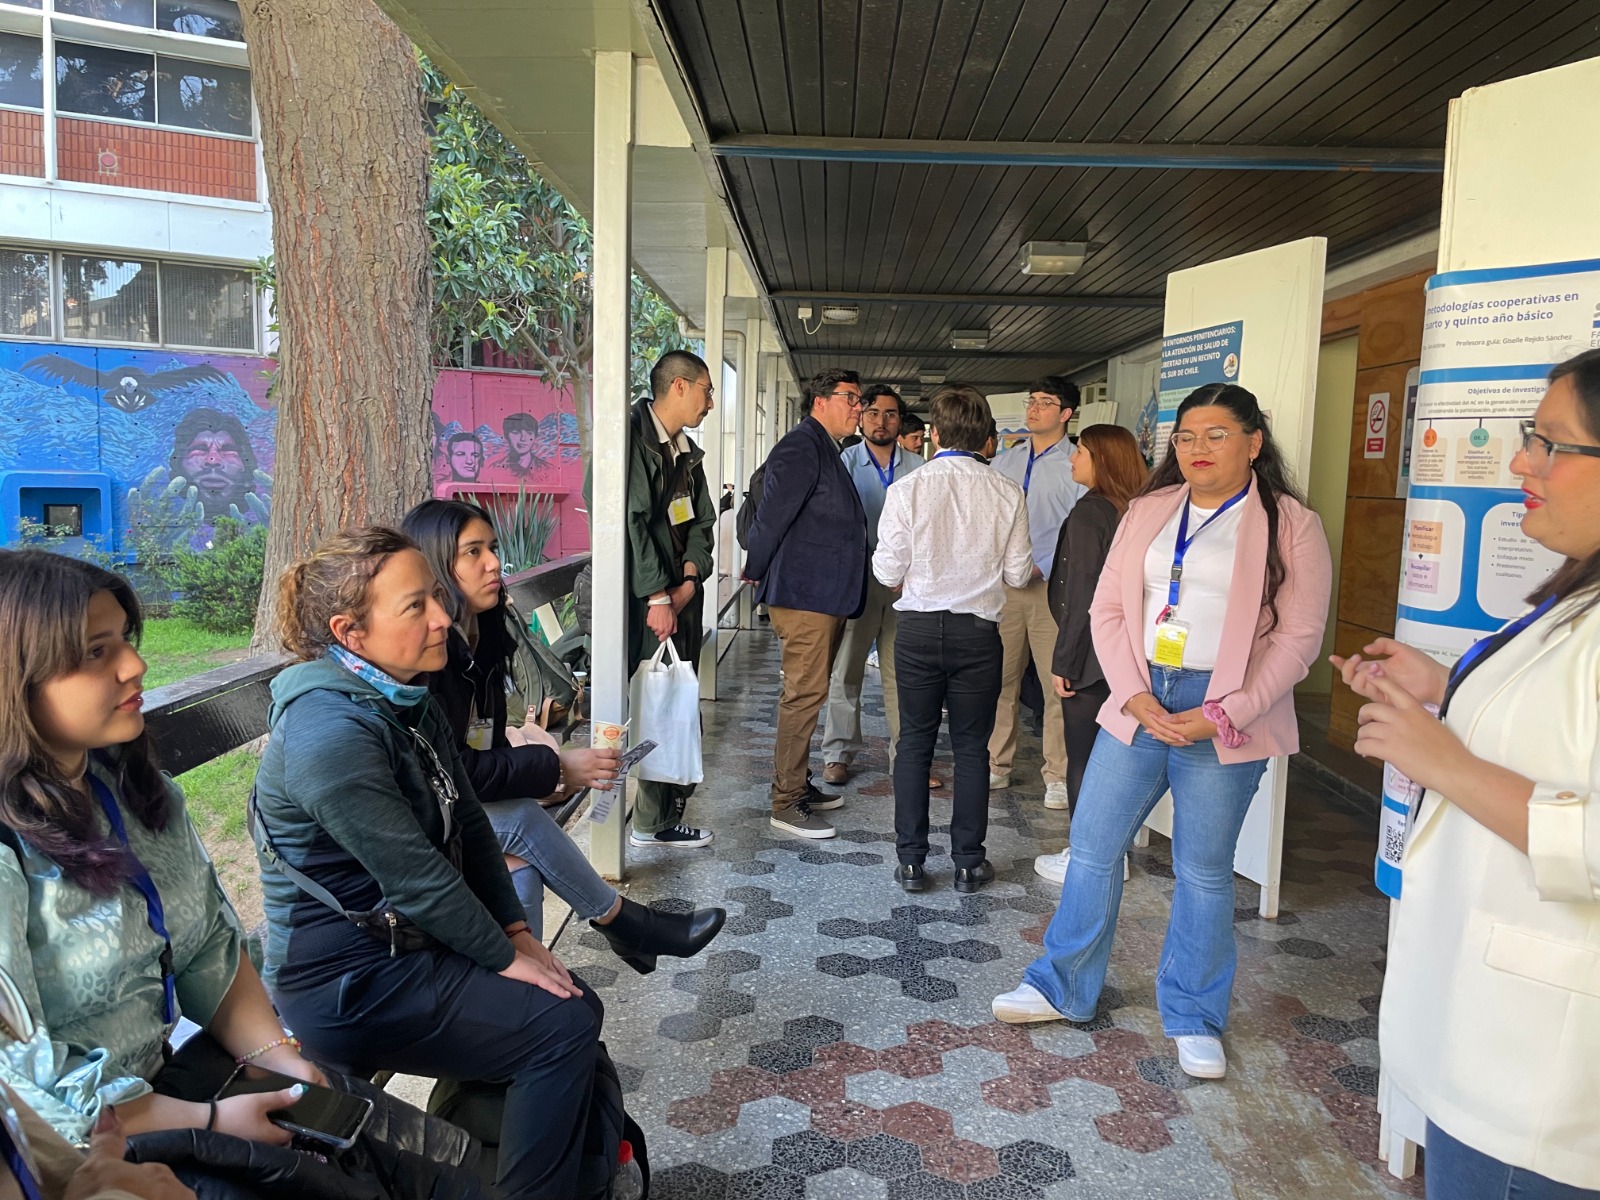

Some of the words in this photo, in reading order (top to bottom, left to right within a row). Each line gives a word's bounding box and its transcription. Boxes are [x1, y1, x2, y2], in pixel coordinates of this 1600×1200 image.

[1487, 293, 1561, 309] cooperativas
[1564, 292, 1579, 301] en
[1444, 320, 1450, 329] y
[1453, 313, 1489, 328] quinto
[1492, 313, 1514, 323] año
[1517, 310, 1553, 321] básico
[1167, 336, 1193, 347] ENTORNOS
[1193, 326, 1236, 341] PENITENCIARIOS:
[1456, 339, 1485, 348] Profesora
[1172, 344, 1196, 357] ATENCIÓN
[1196, 343, 1203, 352] DE
[1203, 340, 1220, 350] SALUD
[1221, 338, 1229, 347] DE
[1182, 357, 1190, 366] EN
[1190, 355, 1198, 364] UN
[1198, 351, 1221, 362] RECINTO
[1167, 369, 1177, 378] SUR
[1177, 367, 1184, 377] DE
[1184, 366, 1200, 376] CHILE.
[1468, 387, 1500, 396] Objetivos
